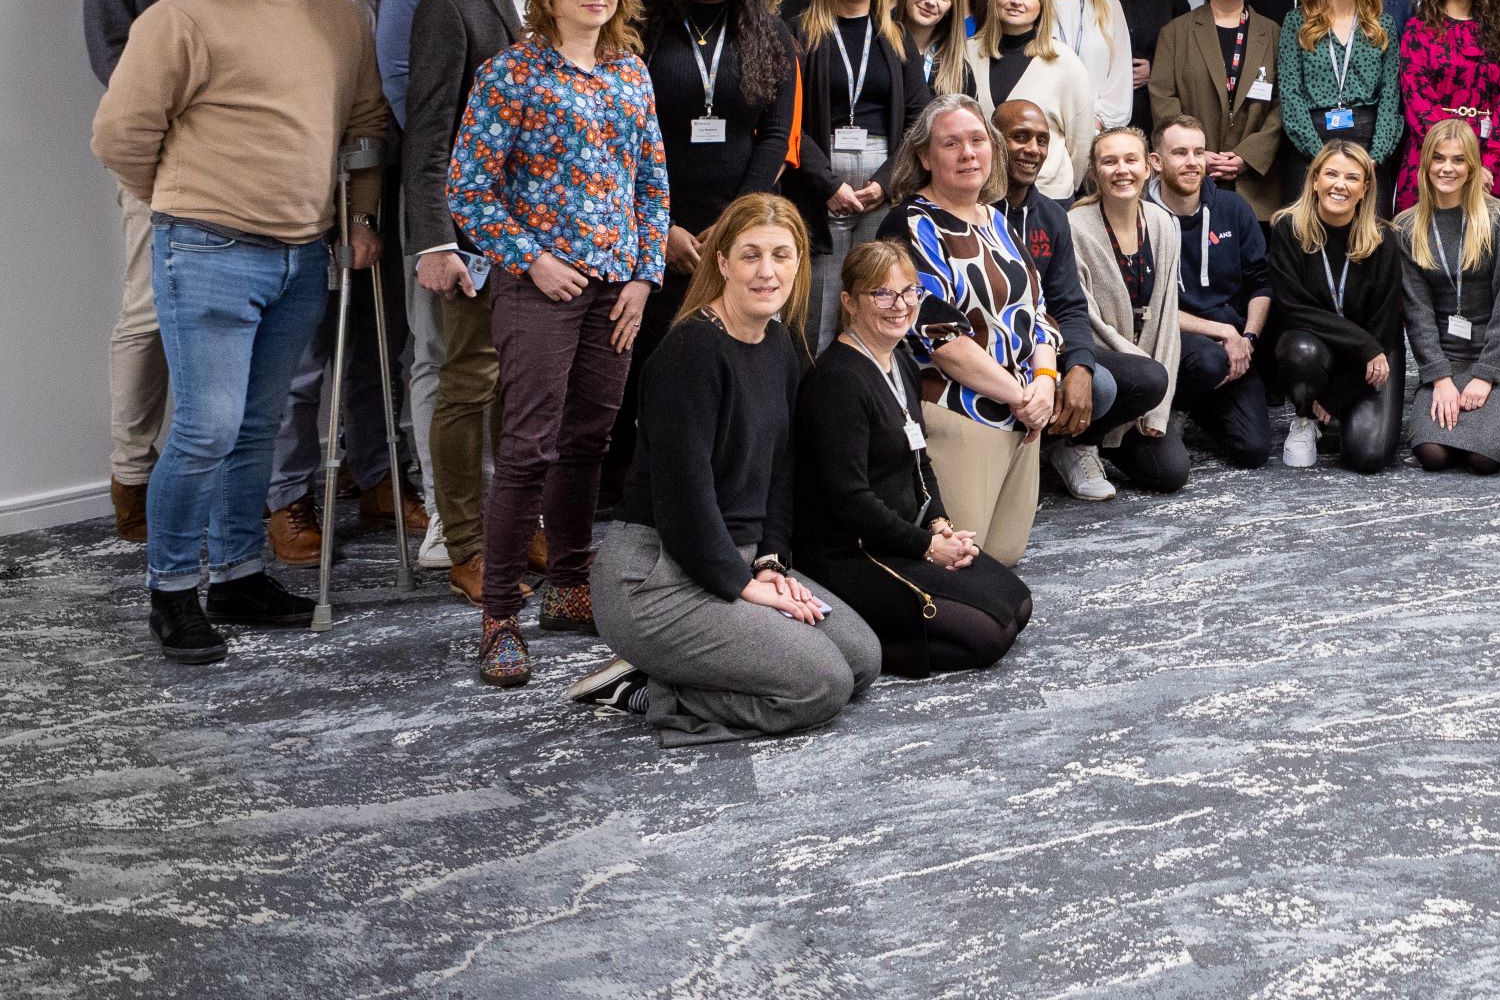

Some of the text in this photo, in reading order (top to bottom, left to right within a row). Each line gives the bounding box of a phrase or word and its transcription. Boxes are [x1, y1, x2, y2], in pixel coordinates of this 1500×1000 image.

[1030, 229, 1050, 242] UA
[1219, 231, 1232, 239] ANS
[1031, 243, 1052, 257] 92
